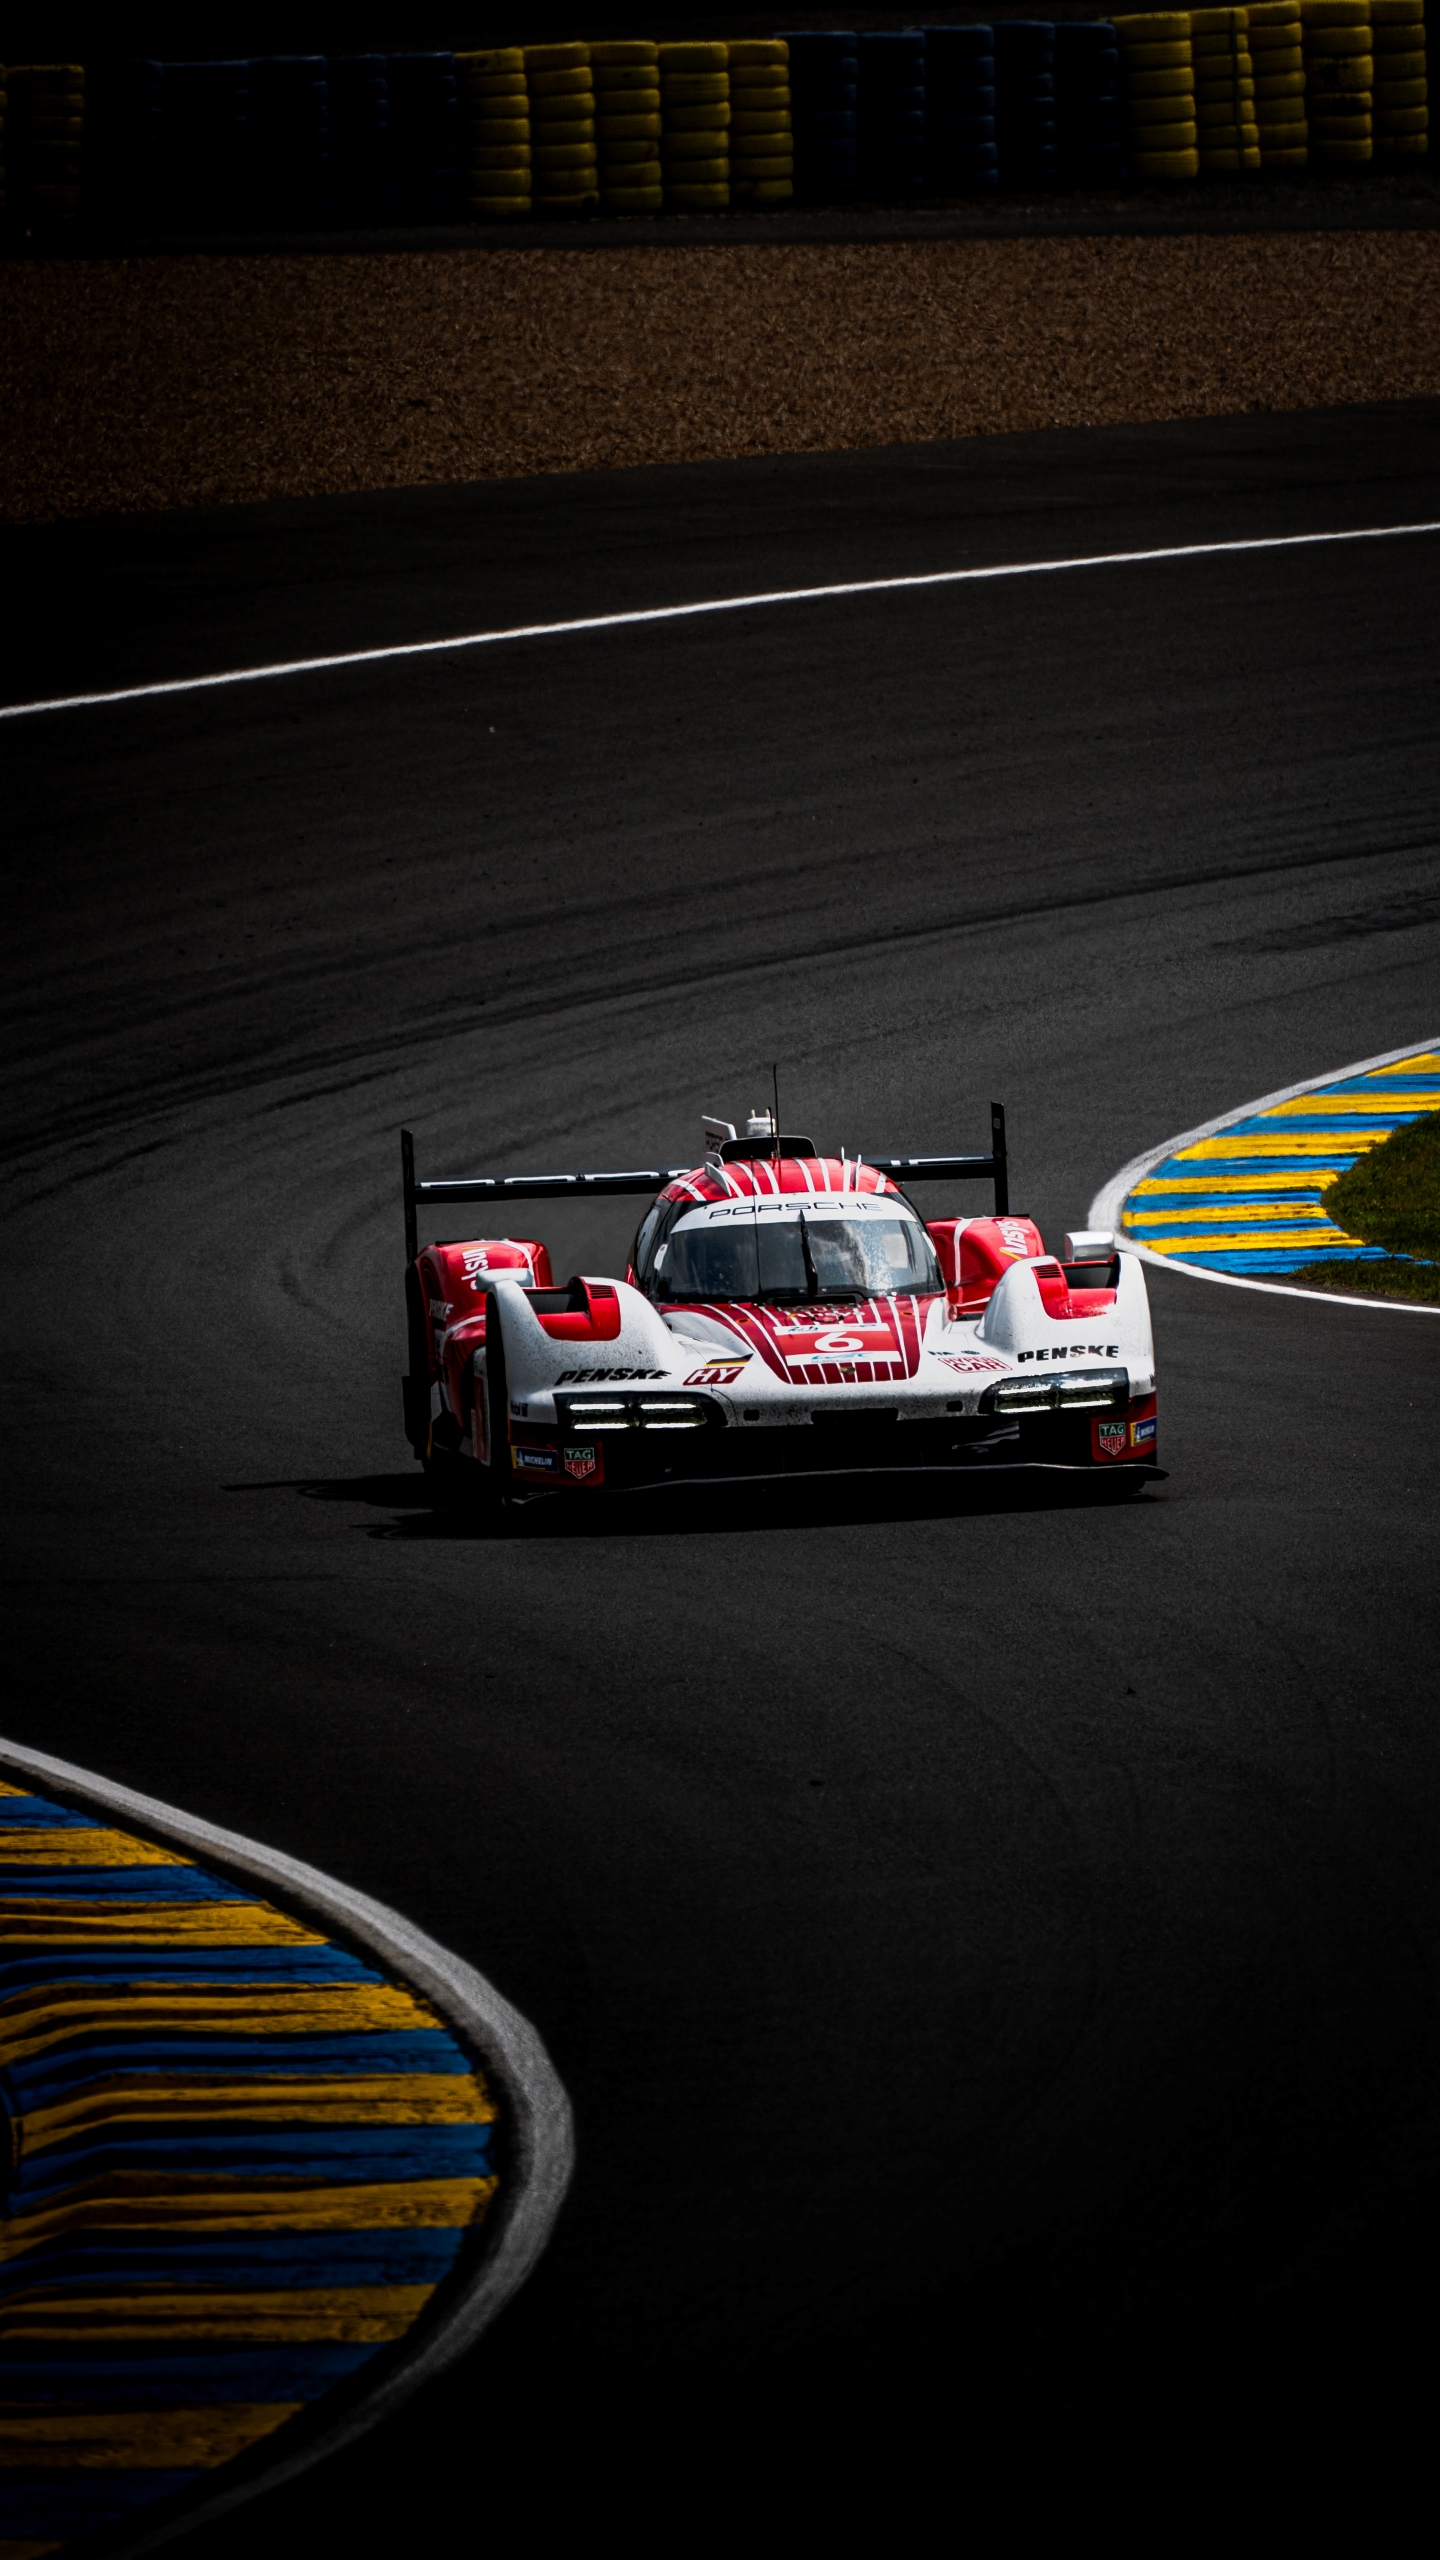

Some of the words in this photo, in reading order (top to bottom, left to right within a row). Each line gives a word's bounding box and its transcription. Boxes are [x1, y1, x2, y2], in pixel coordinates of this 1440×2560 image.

[709, 1202, 882, 1219] PORSCHE
[814, 1331, 864, 1352] 6
[1017, 1345, 1119, 1363] PENSKE
[953, 1361, 1007, 1372] CAR
[554, 1368, 672, 1387] PENSKE
[687, 1367, 740, 1384] HY
[1101, 1424, 1124, 1437] TAG
[1101, 1437, 1125, 1453] HEUER
[524, 1455, 553, 1466] MICHELIN
[566, 1450, 591, 1460] TAG
[566, 1461, 593, 1476] HEUER
